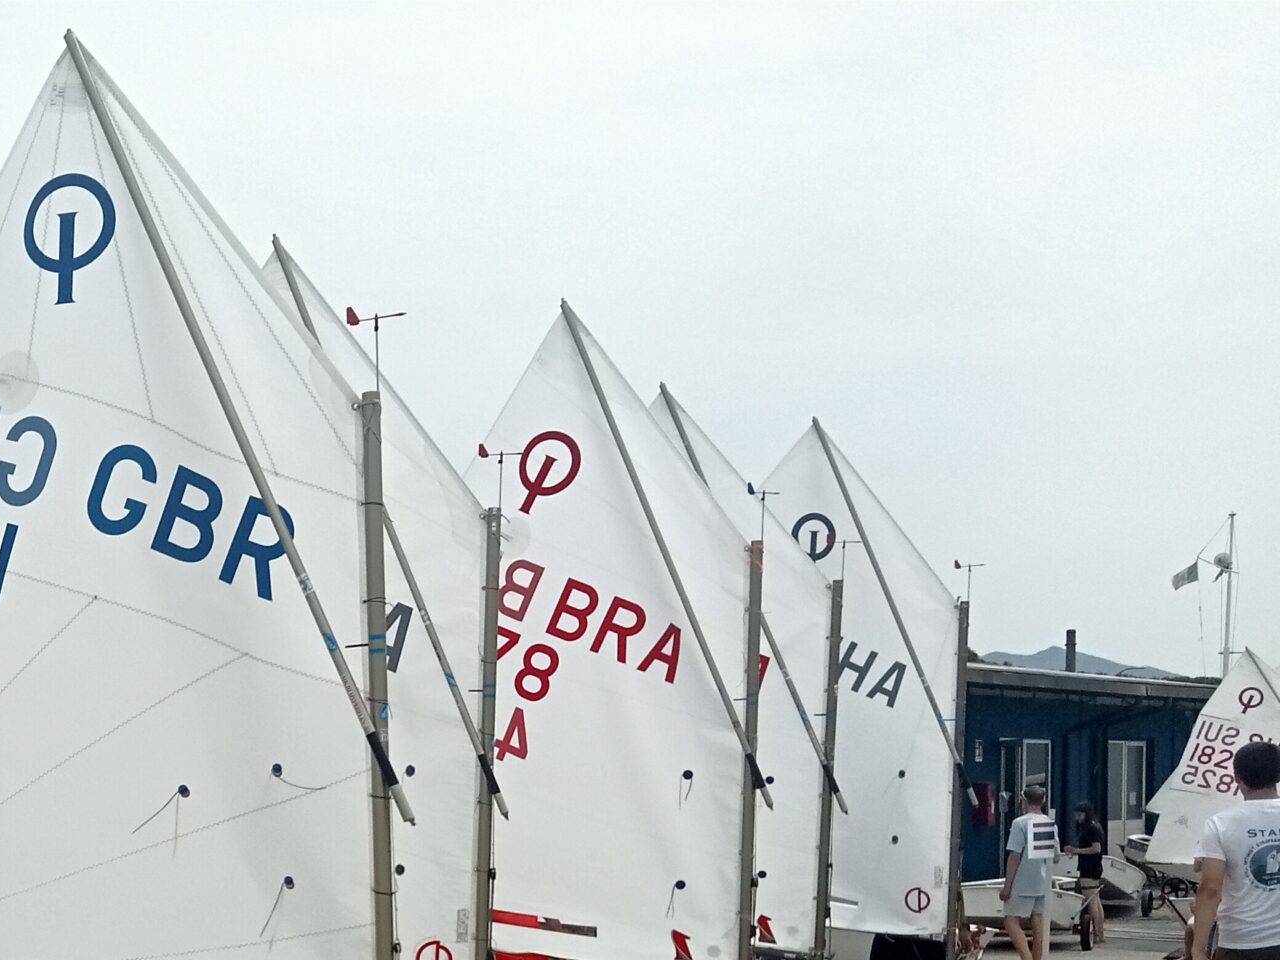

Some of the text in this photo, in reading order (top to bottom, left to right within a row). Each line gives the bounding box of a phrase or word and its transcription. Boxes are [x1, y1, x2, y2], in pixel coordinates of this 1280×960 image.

[86, 443, 295, 602] GBR
[497, 625, 560, 702] 78
[545, 577, 682, 684] BRA
[837, 640, 908, 709] HA
[1189, 742, 1234, 770] 182
[1247, 828, 1280, 838] STA
